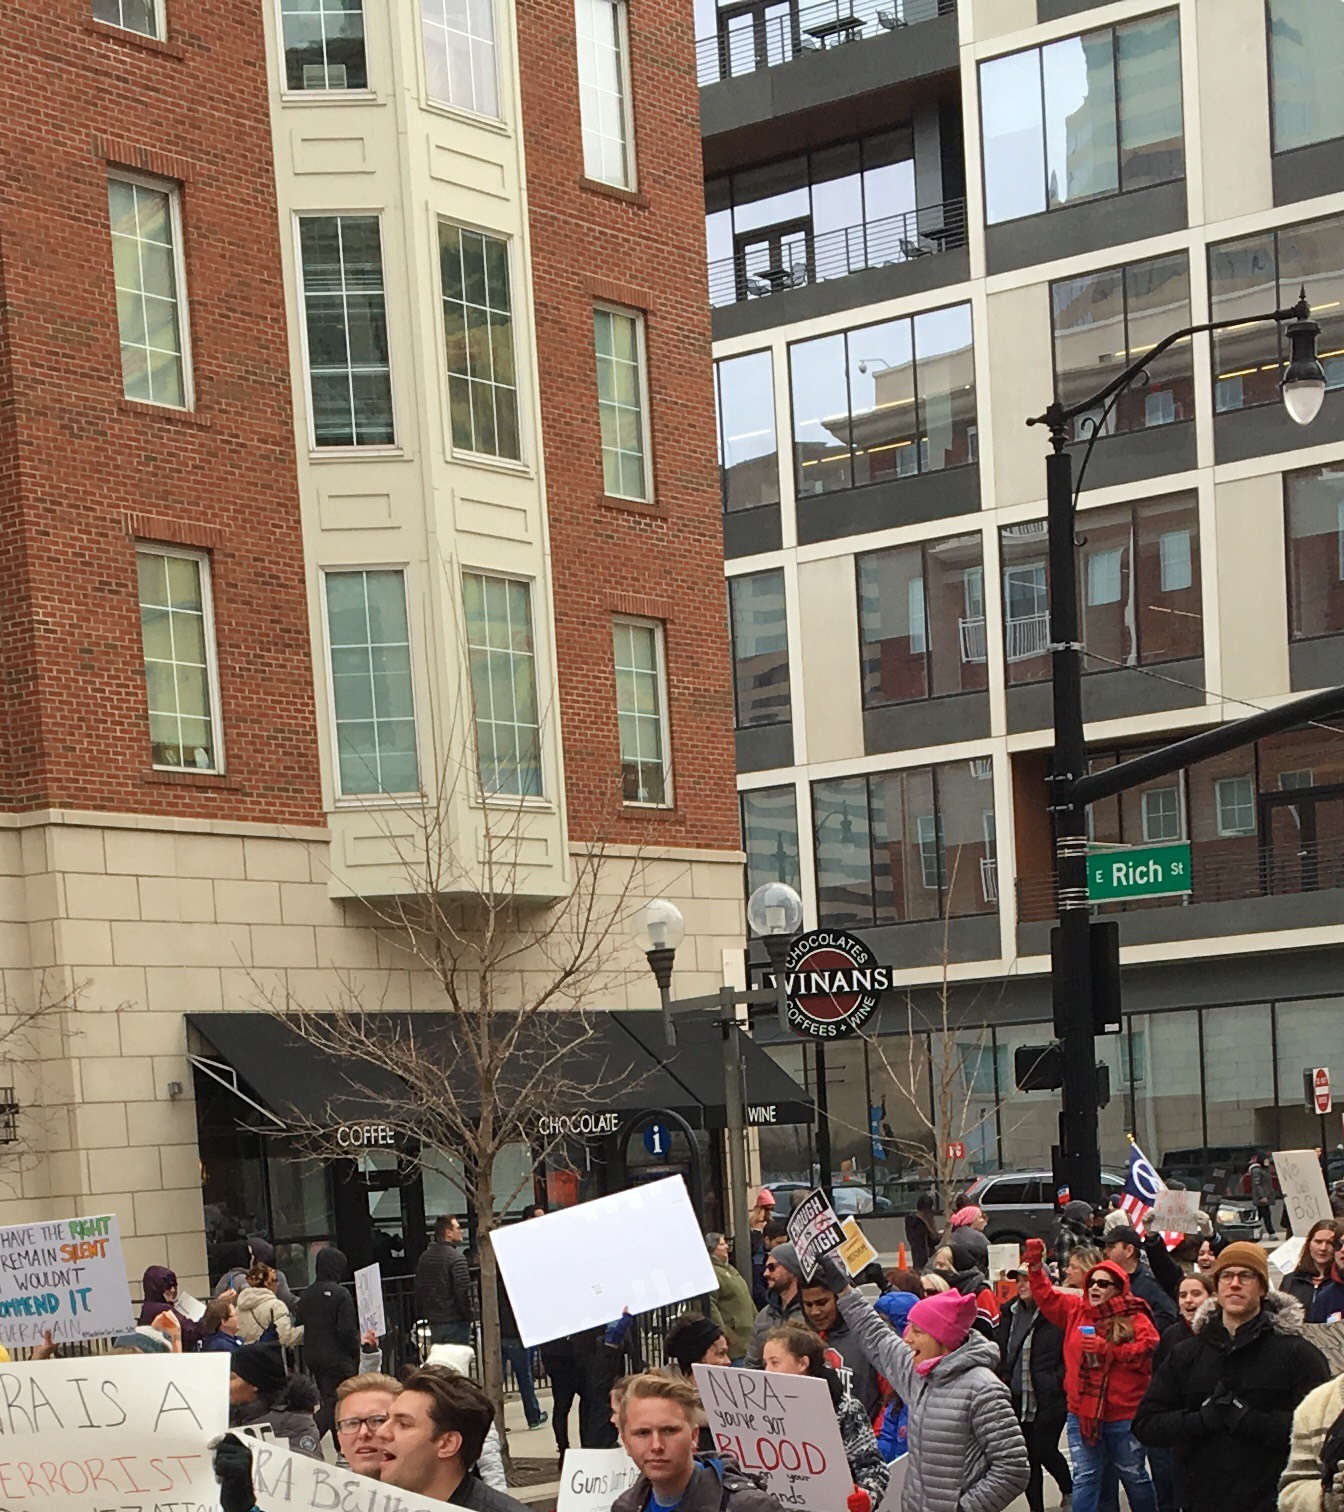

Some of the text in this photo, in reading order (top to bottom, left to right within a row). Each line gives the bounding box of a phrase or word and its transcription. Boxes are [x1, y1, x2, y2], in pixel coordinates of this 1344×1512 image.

[1096, 859, 1183, 887] E Rich St
[786, 933, 868, 968] CHOCOLATES
[769, 968, 889, 996] WINANS
[786, 1000, 837, 1036] COFFEES
[849, 996, 875, 1026] WINE
[337, 1106, 777, 1148] COFFEE CHOCOLATE WINE
[0, 1227, 35, 1250] HAVE
[40, 1223, 65, 1242] THE
[68, 1216, 111, 1241] RIGHT
[789, 1196, 824, 1238] ENOUGH
[0, 1247, 57, 1273] REMAIN
[59, 1238, 109, 1264] SILENT
[69, 1287, 93, 1316] IT
[67, 1378, 127, 1429] IS
[154, 1380, 203, 1432] A
[716, 1433, 826, 1475] BLOOD
[248, 1443, 295, 1501] RA
[571, 1469, 607, 1495] Guns
[787, 1473, 810, 1484] your
[771, 1485, 807, 1506] nds
